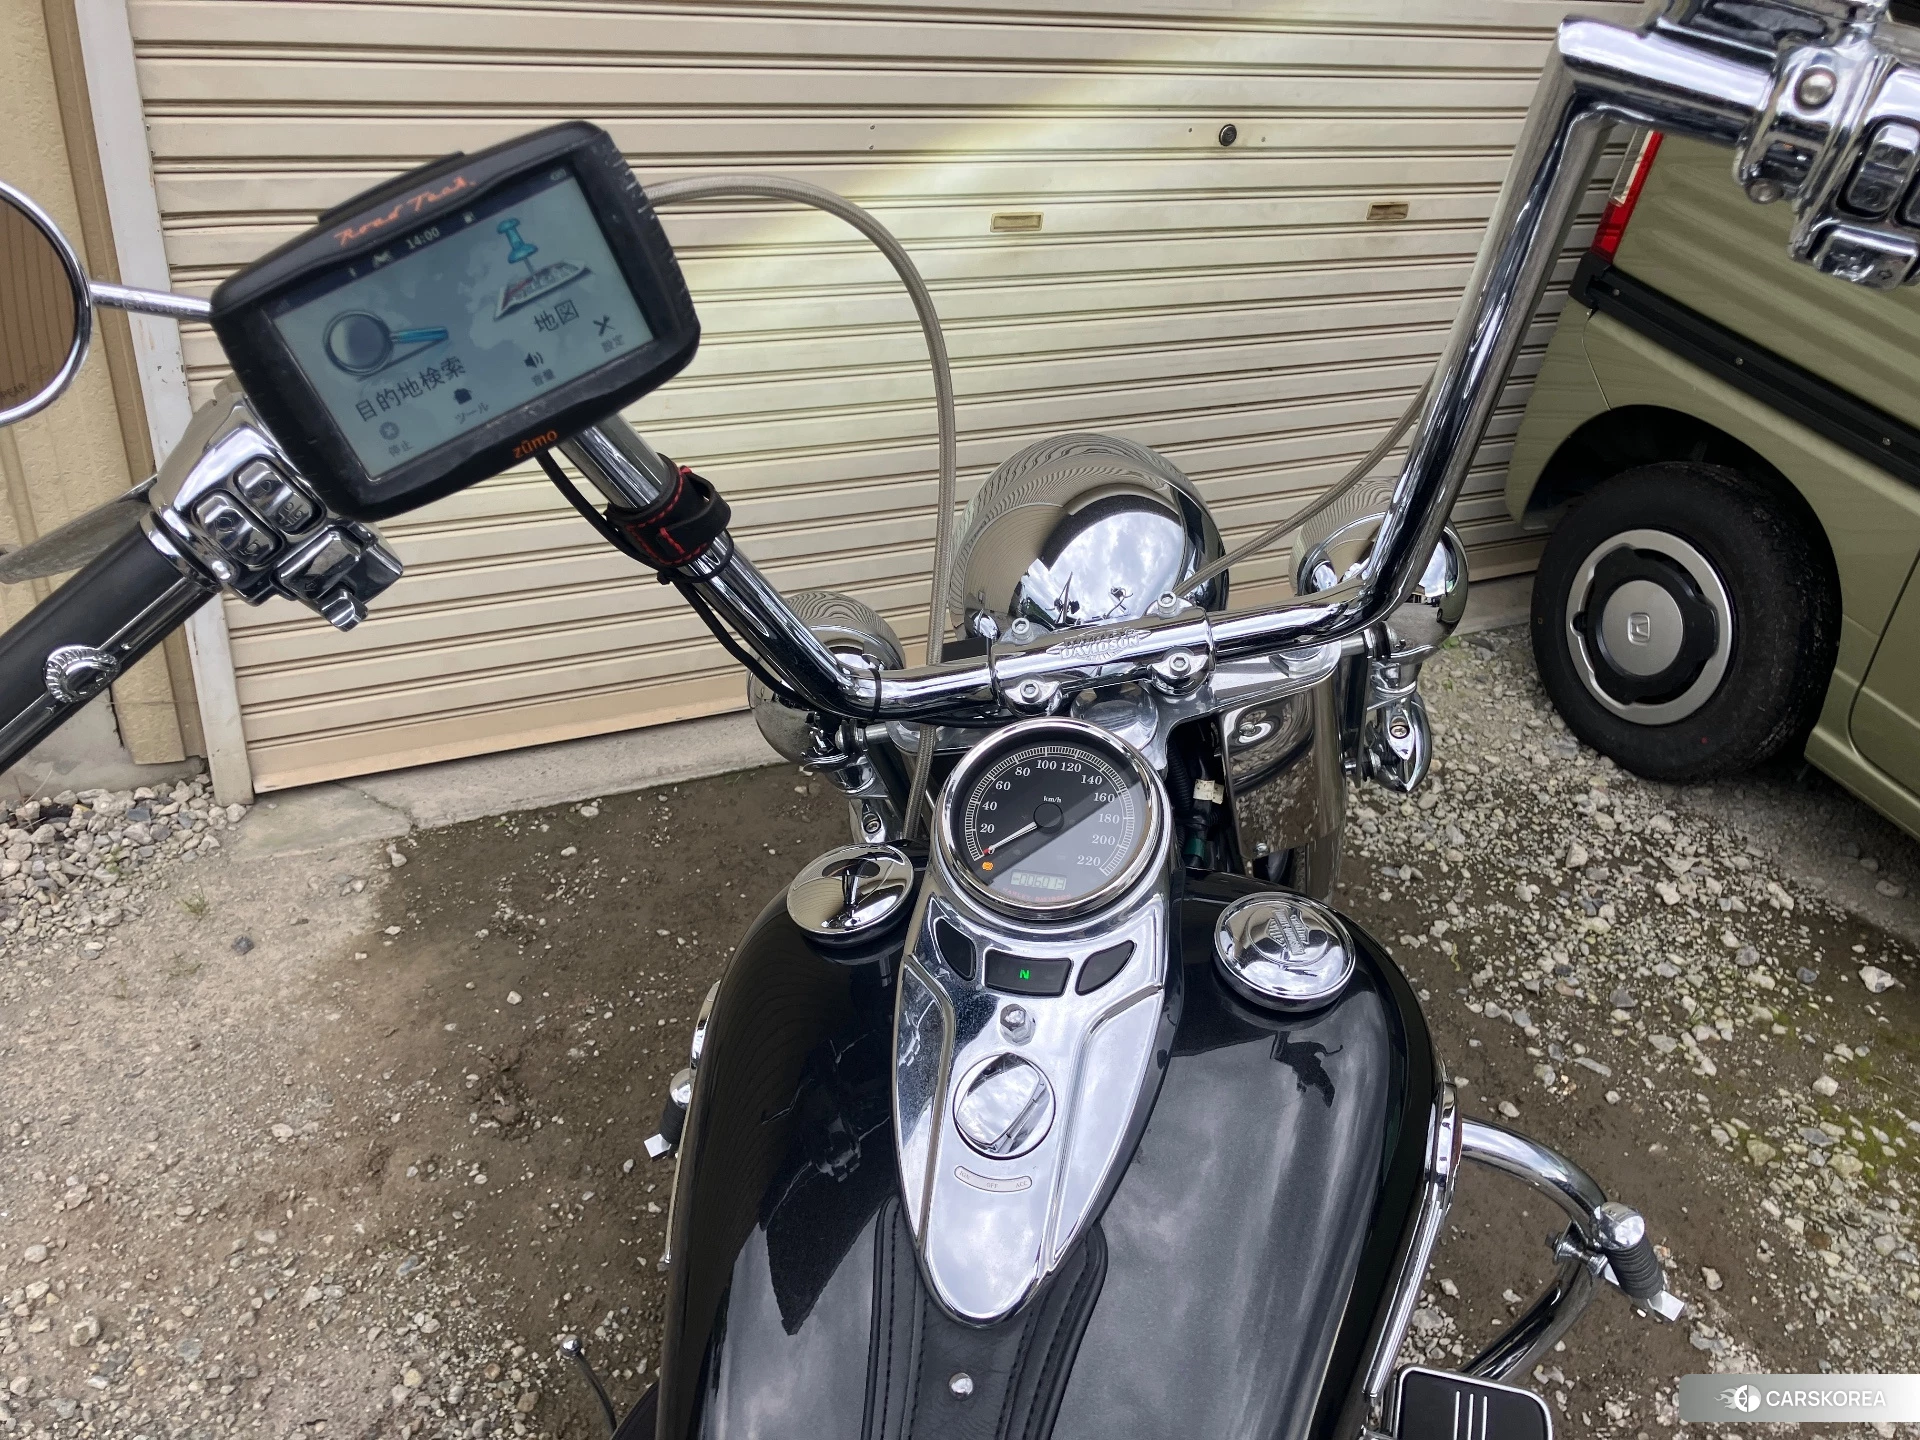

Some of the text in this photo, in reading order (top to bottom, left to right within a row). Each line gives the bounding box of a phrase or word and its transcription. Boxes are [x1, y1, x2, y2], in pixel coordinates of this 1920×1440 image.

[406, 227, 440, 250] 14:00
[533, 299, 580, 333] 地図
[355, 356, 465, 422] 目的地検索
[1061, 634, 1140, 659] DAVIDSON
[1035, 759, 1057, 770] 100
[1060, 762, 1082, 773] 120
[1014, 767, 1030, 777] 80
[1081, 774, 1103, 785] 140
[995, 780, 1011, 791] 60
[1043, 795, 1062, 803] km/h
[1093, 792, 1116, 803] 160
[982, 801, 997, 811] 40
[1098, 813, 1120, 824] 180
[980, 823, 995, 833] 20
[1092, 834, 1116, 846] 200
[1077, 855, 1101, 867] 220
[1019, 969, 1030, 980] N
